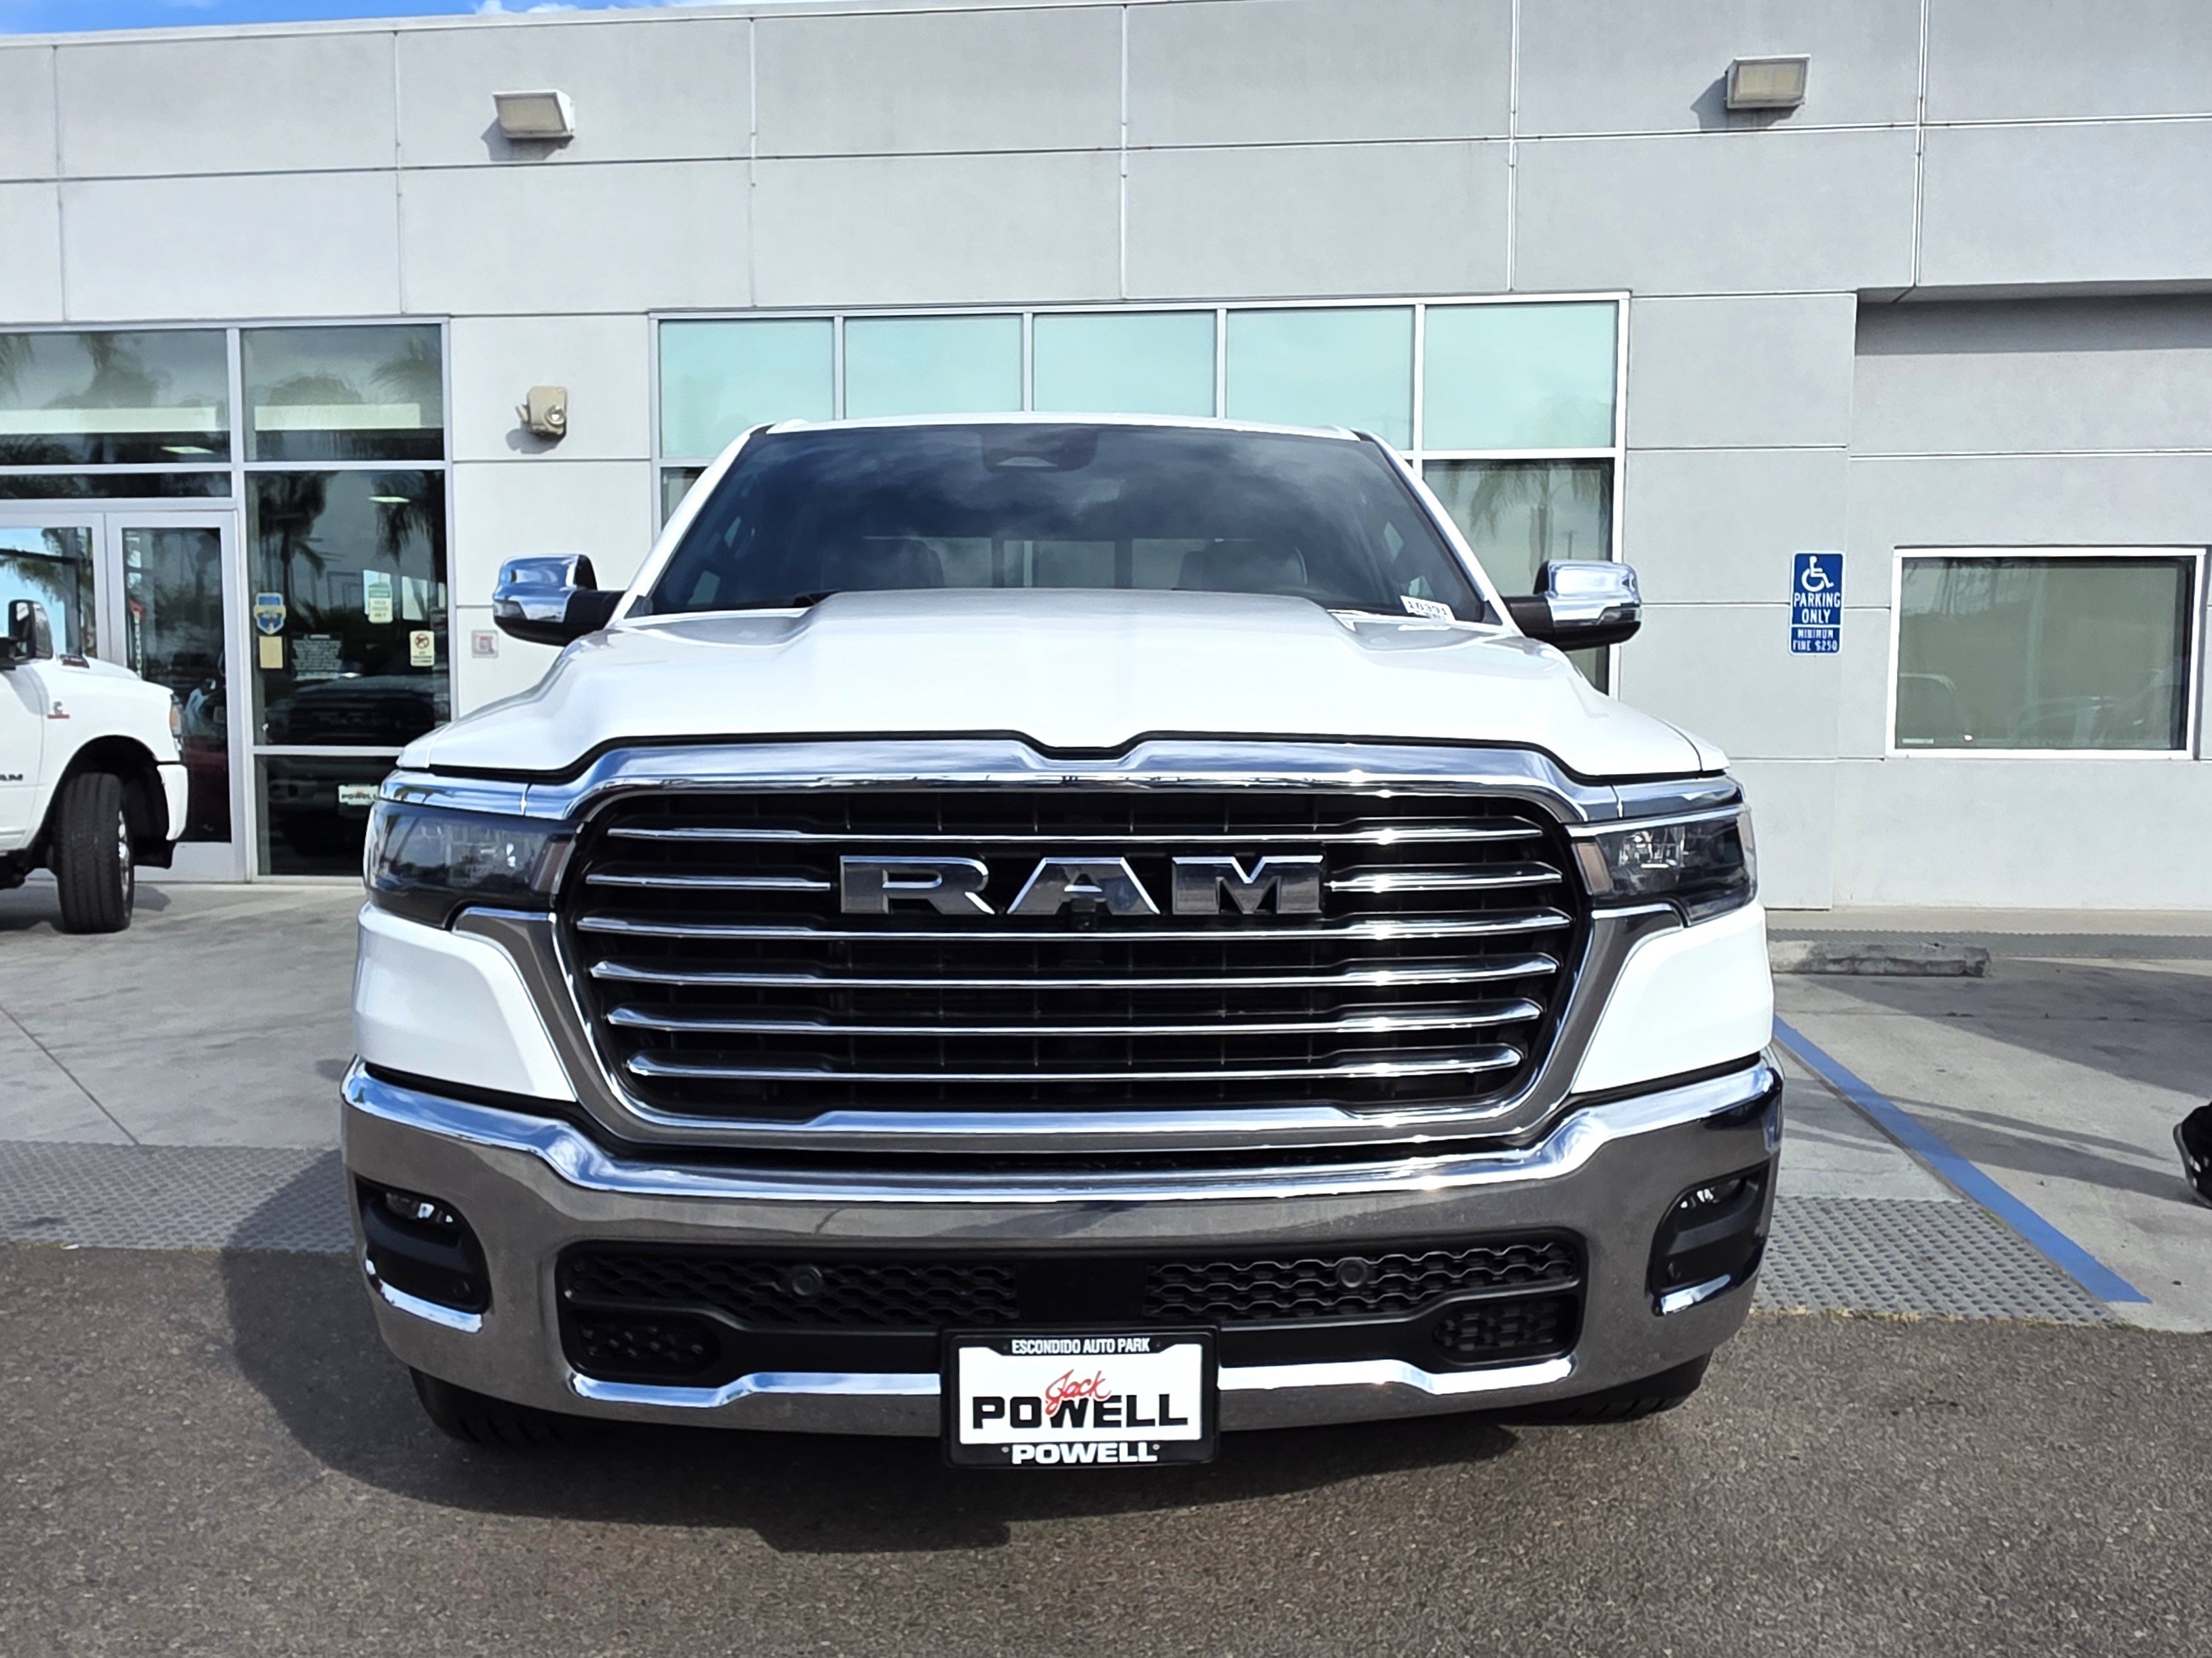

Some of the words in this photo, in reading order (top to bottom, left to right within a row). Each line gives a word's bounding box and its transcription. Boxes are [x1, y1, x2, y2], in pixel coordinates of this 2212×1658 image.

[1794, 592, 1841, 608] PARKING
[1802, 609, 1830, 624] ONLY
[1798, 629, 1834, 639] MINIMUM
[1792, 640, 1811, 651] FINE
[1815, 640, 1838, 651] $250
[0, 773, 23, 781] AM
[840, 855, 1324, 915] RAM
[1012, 1339, 1081, 1355] ESCONDIDO
[1083, 1338, 1116, 1353] AUTO
[1117, 1338, 1150, 1352] PARK
[1045, 1369, 1112, 1416] Jack
[973, 1393, 1189, 1430] POWELL
[1012, 1442, 1158, 1464] POWELL
